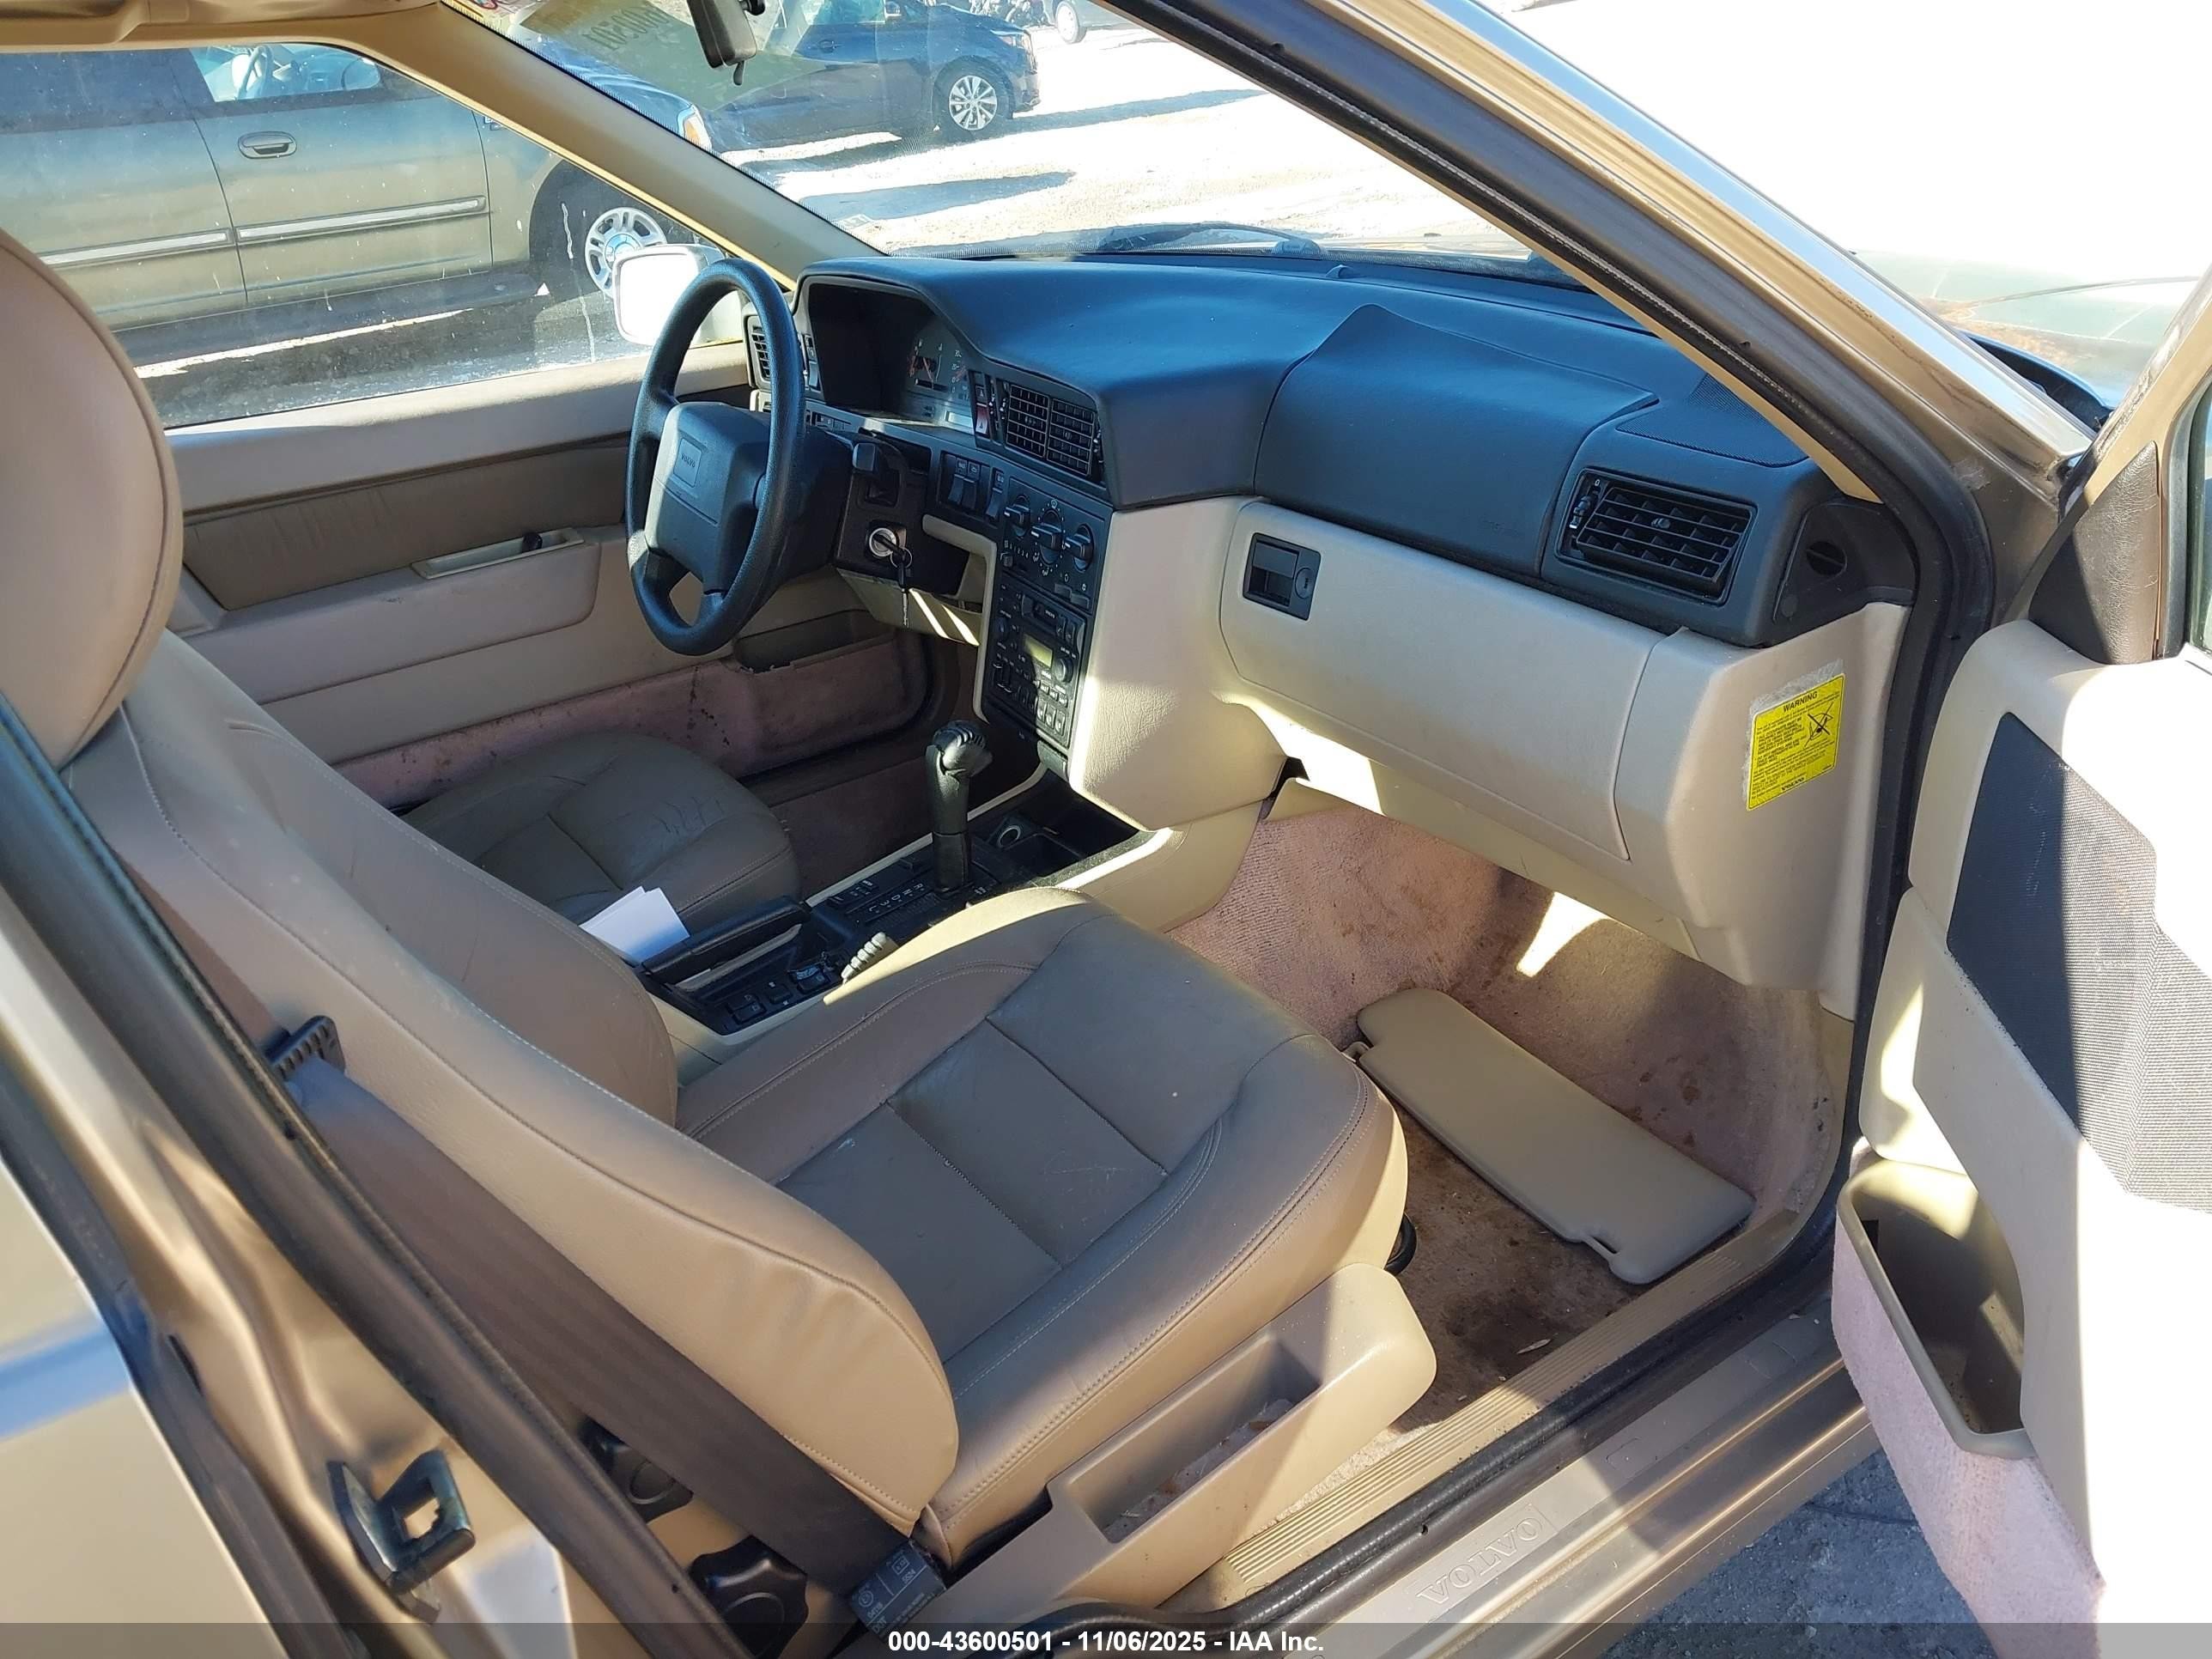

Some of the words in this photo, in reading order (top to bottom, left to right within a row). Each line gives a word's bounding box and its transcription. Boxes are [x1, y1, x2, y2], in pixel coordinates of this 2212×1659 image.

[681, 453, 696, 468] VOLVO
[1783, 691, 1818, 713] WARNING
[1416, 1517, 1543, 1604] VOLVO
